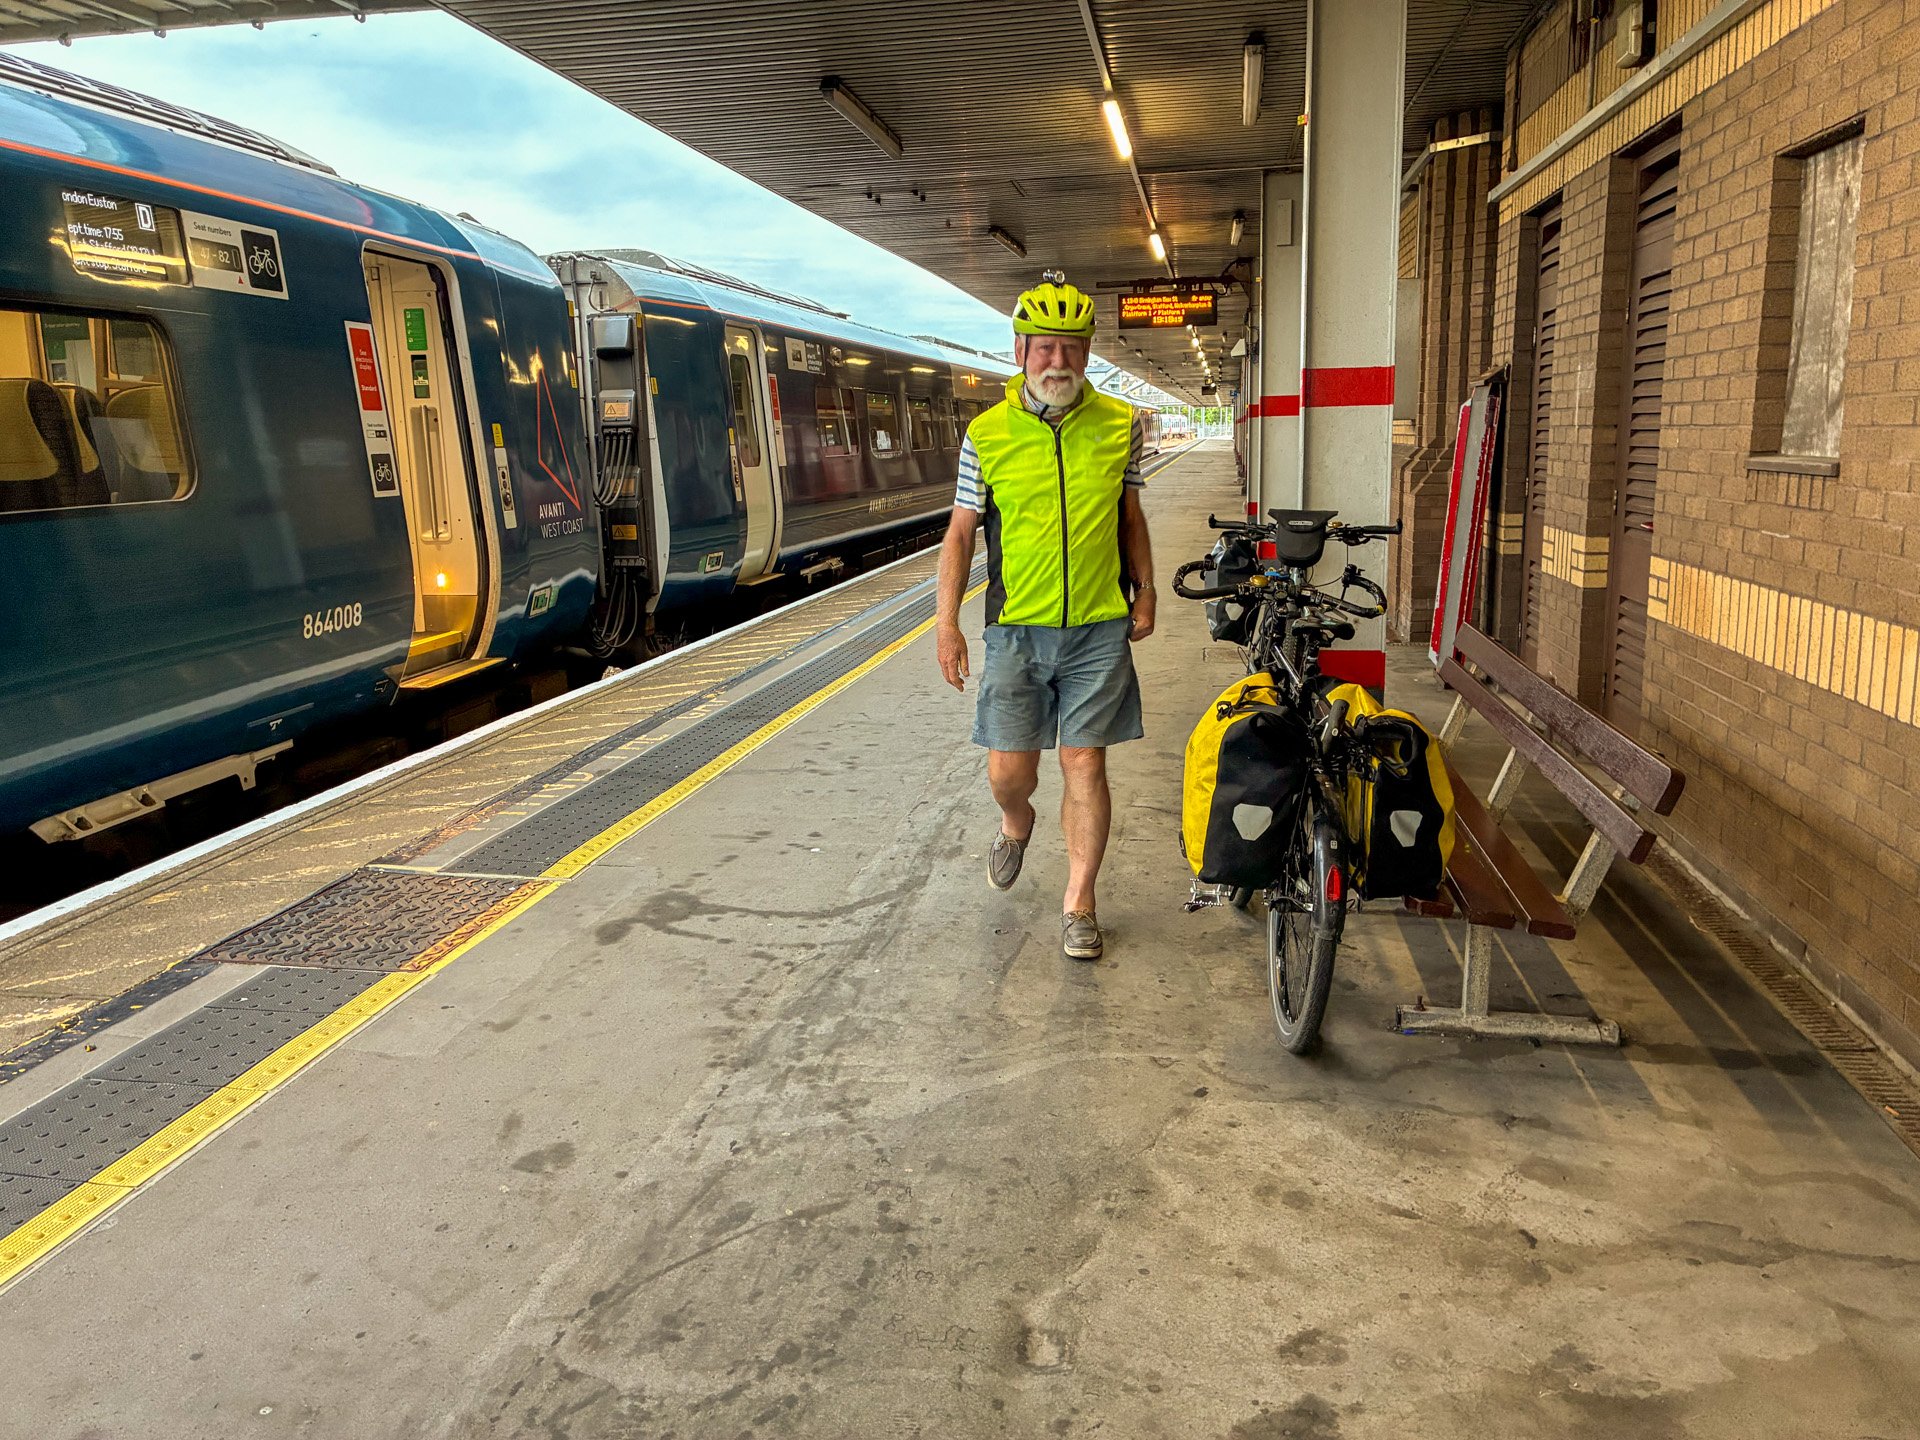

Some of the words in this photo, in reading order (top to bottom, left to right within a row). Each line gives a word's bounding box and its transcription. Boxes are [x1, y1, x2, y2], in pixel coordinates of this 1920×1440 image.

[87, 193, 118, 211] Euston
[139, 206, 151, 228] D
[193, 221, 207, 232] Seat
[207, 226, 232, 237] numbers
[200, 247, 210, 260] 47
[218, 250, 231, 264] 82
[539, 501, 566, 519] AVANTI
[540, 521, 560, 539] WEST
[562, 518, 584, 535] COAST
[303, 602, 363, 639] 864008
